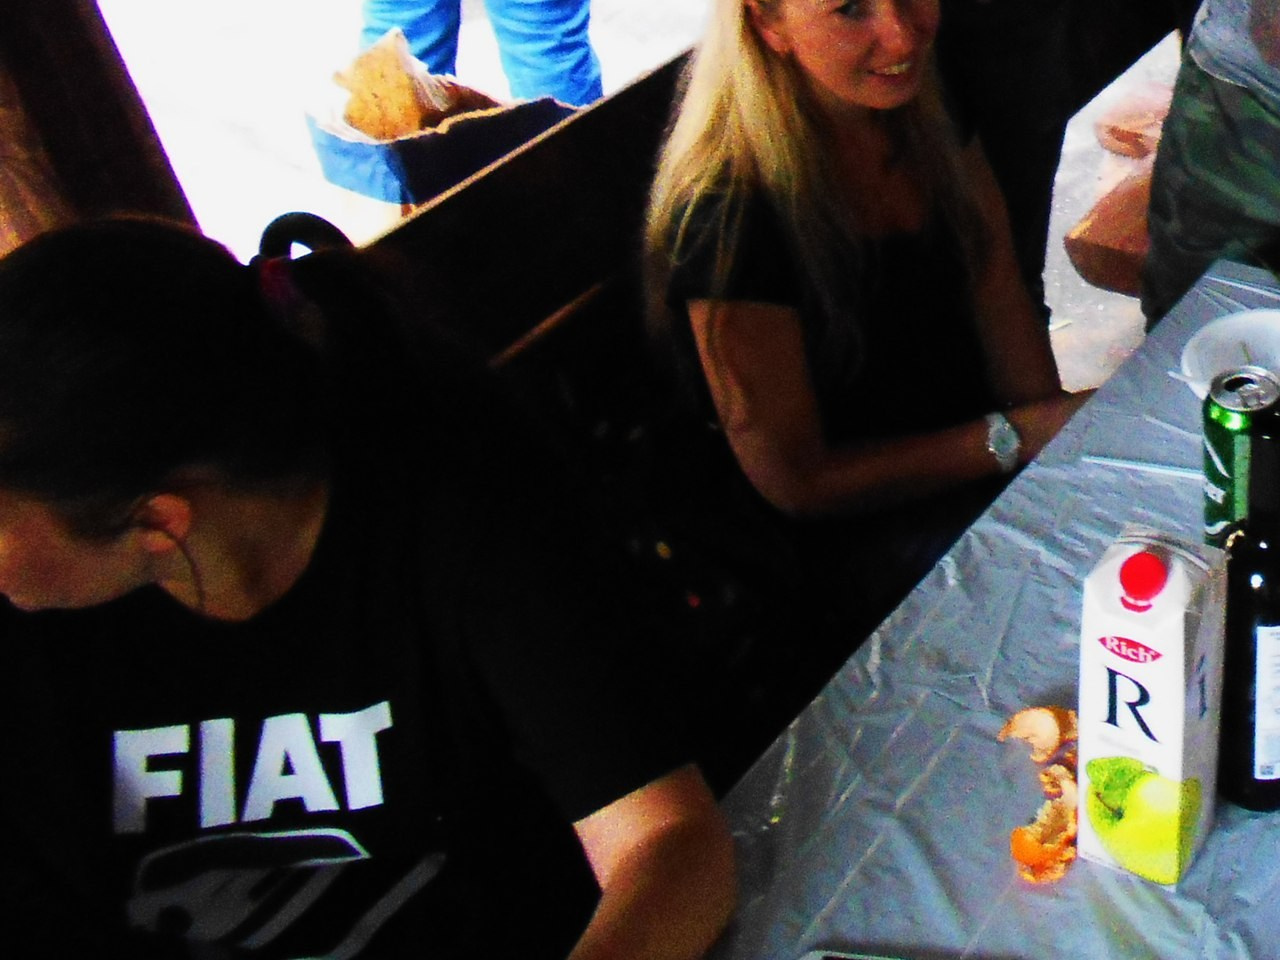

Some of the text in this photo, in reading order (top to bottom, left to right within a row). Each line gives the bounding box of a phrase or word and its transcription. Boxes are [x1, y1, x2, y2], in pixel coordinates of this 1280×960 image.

[1104, 636, 1153, 664] Rich
[1099, 666, 1161, 744] R
[113, 700, 394, 834] FIAT
